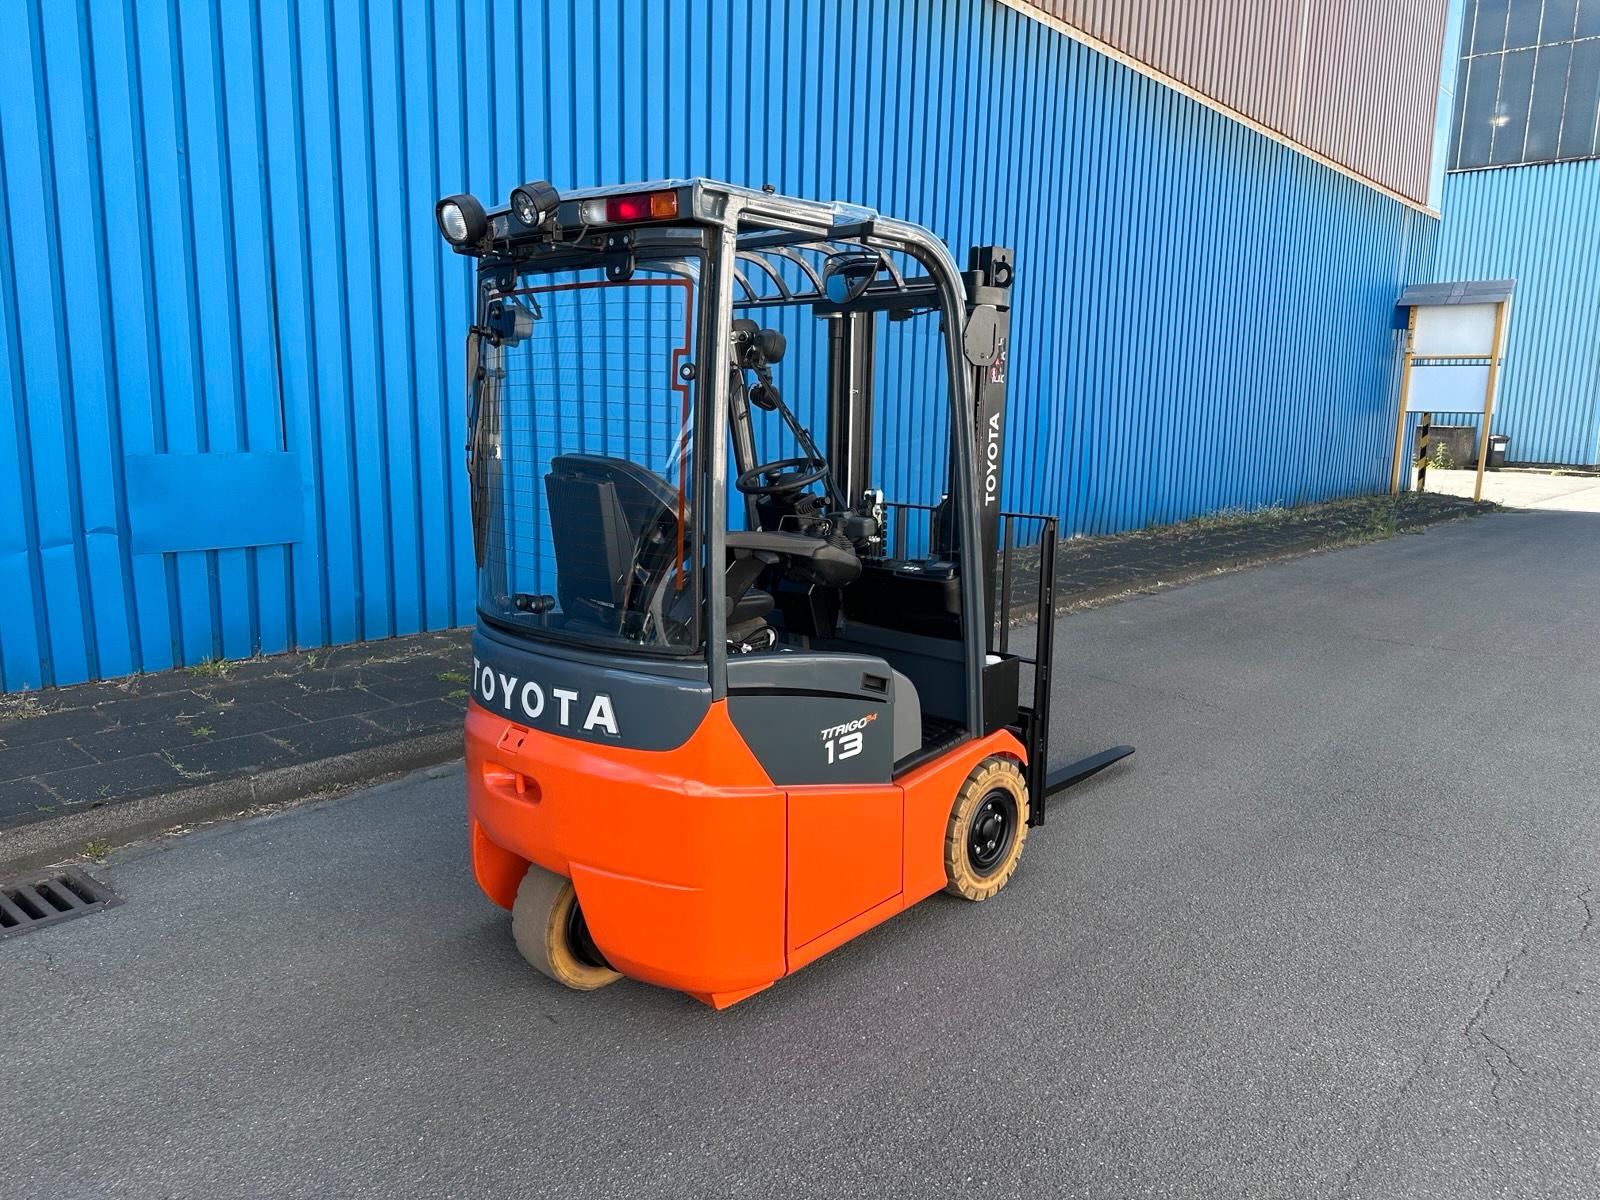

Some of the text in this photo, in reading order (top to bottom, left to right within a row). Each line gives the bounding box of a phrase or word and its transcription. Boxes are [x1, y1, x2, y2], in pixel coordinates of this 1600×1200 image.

[985, 412, 1000, 507] TOYOTA
[473, 656, 620, 734] TOYOTA
[825, 731, 863, 765] 13
